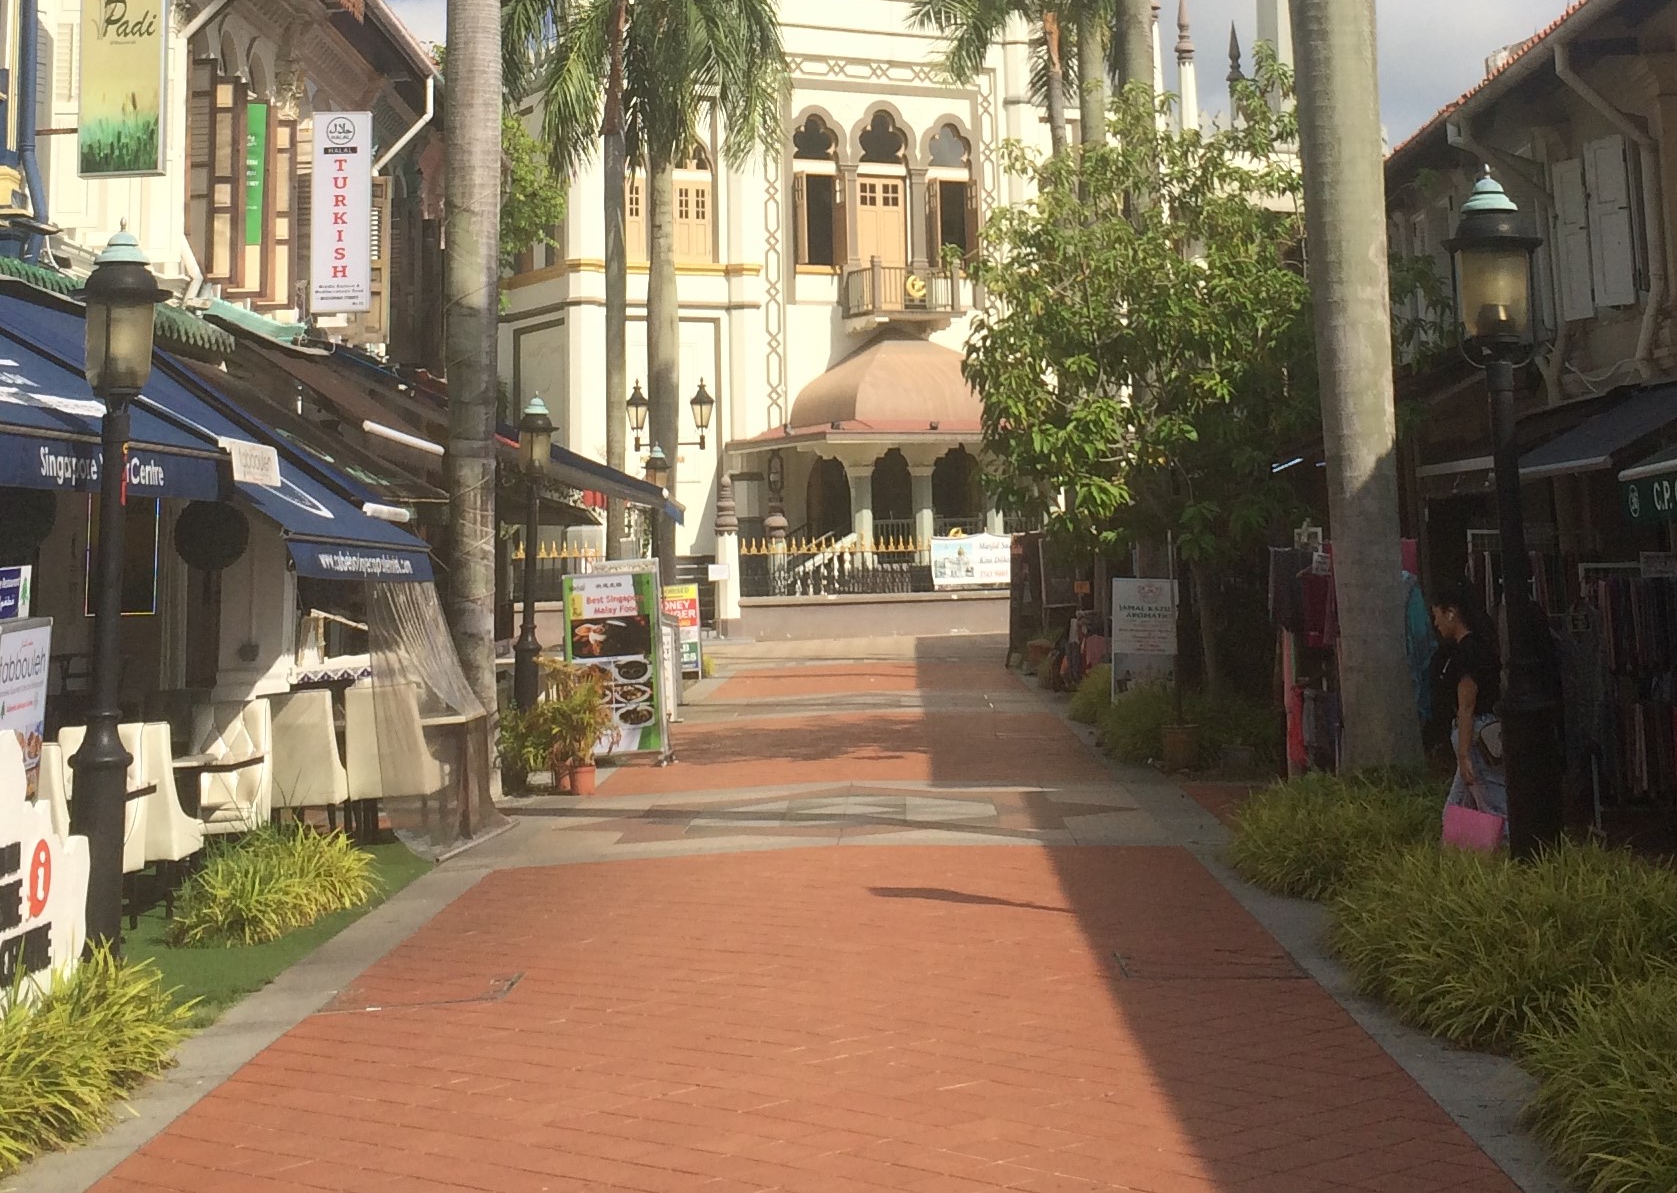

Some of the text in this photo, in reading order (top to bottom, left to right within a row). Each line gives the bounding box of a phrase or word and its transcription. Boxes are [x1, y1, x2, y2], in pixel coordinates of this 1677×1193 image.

[329, 122, 353, 135] حلال
[332, 159, 349, 278] TURKISH
[40, 446, 98, 486] Singapore
[130, 457, 165, 486] Centre
[586, 595, 604, 605] Best
[594, 606, 617, 615] Malay
